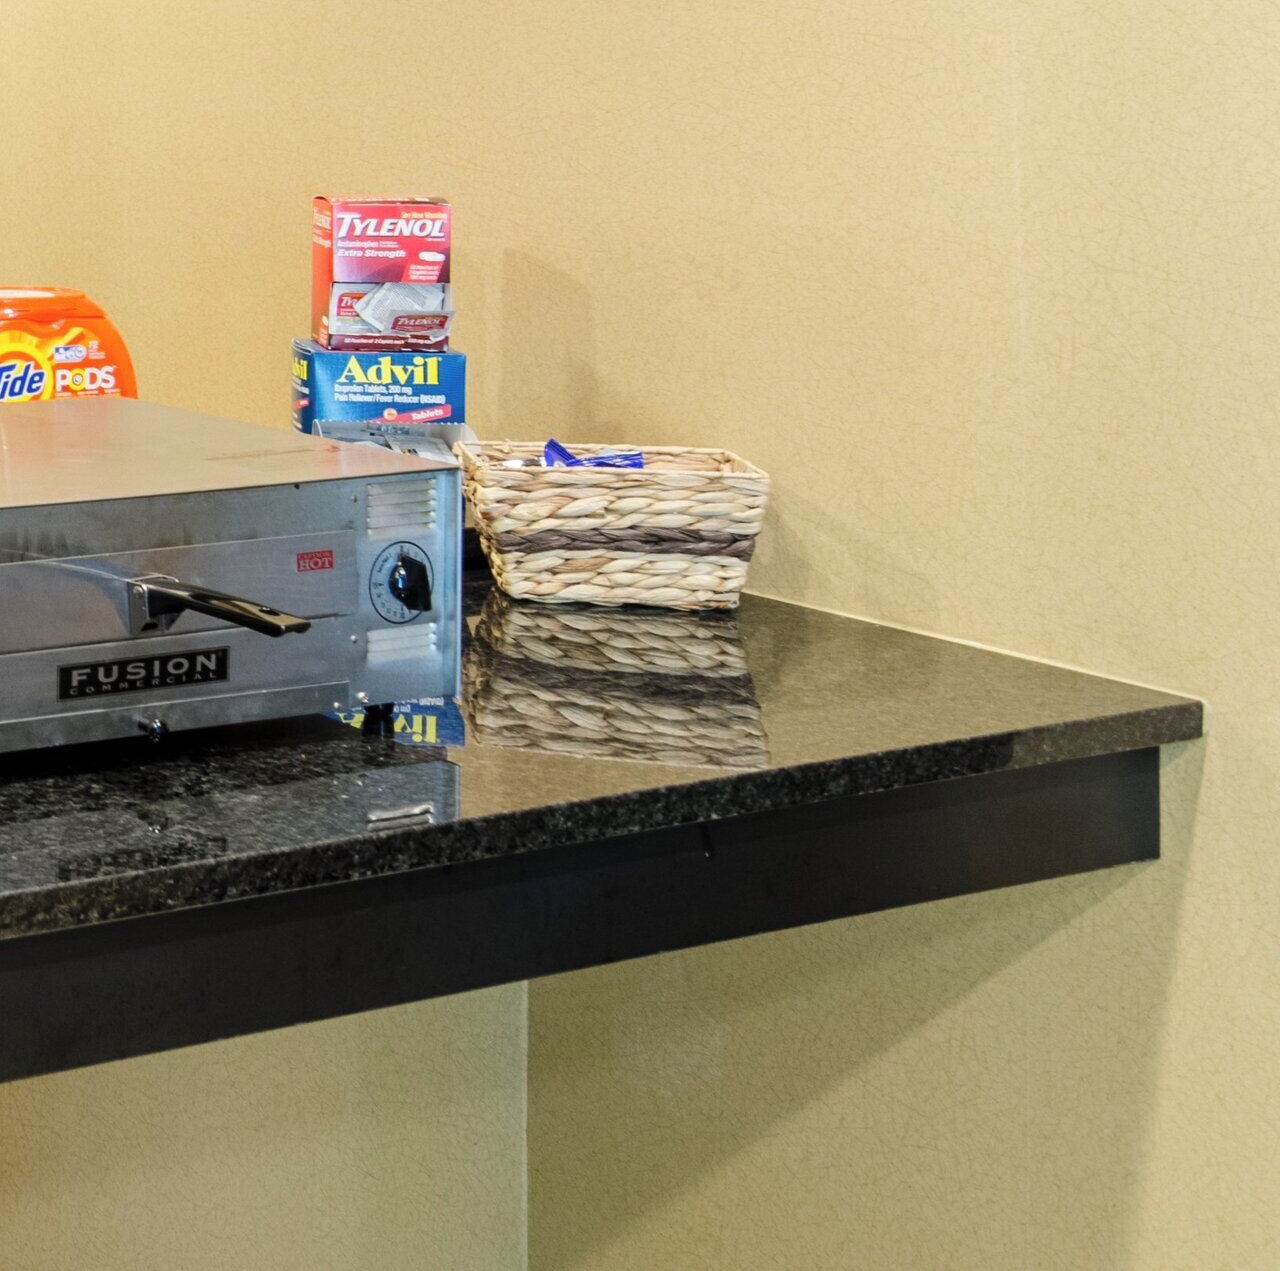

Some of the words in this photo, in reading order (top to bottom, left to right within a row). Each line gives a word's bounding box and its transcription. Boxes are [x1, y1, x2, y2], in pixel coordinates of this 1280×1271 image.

[336, 213, 446, 239] TYLENOL
[337, 249, 363, 258] Extra
[365, 249, 406, 259] Strength
[55, 365, 116, 393] PODS
[336, 355, 439, 385] Advil
[335, 393, 348, 401] Pain
[394, 394, 419, 404] Reducer
[411, 409, 444, 421] Tablets
[299, 558, 332, 570] HOT
[71, 653, 218, 686] FUSION
[69, 672, 218, 695] COMMERCIAL
